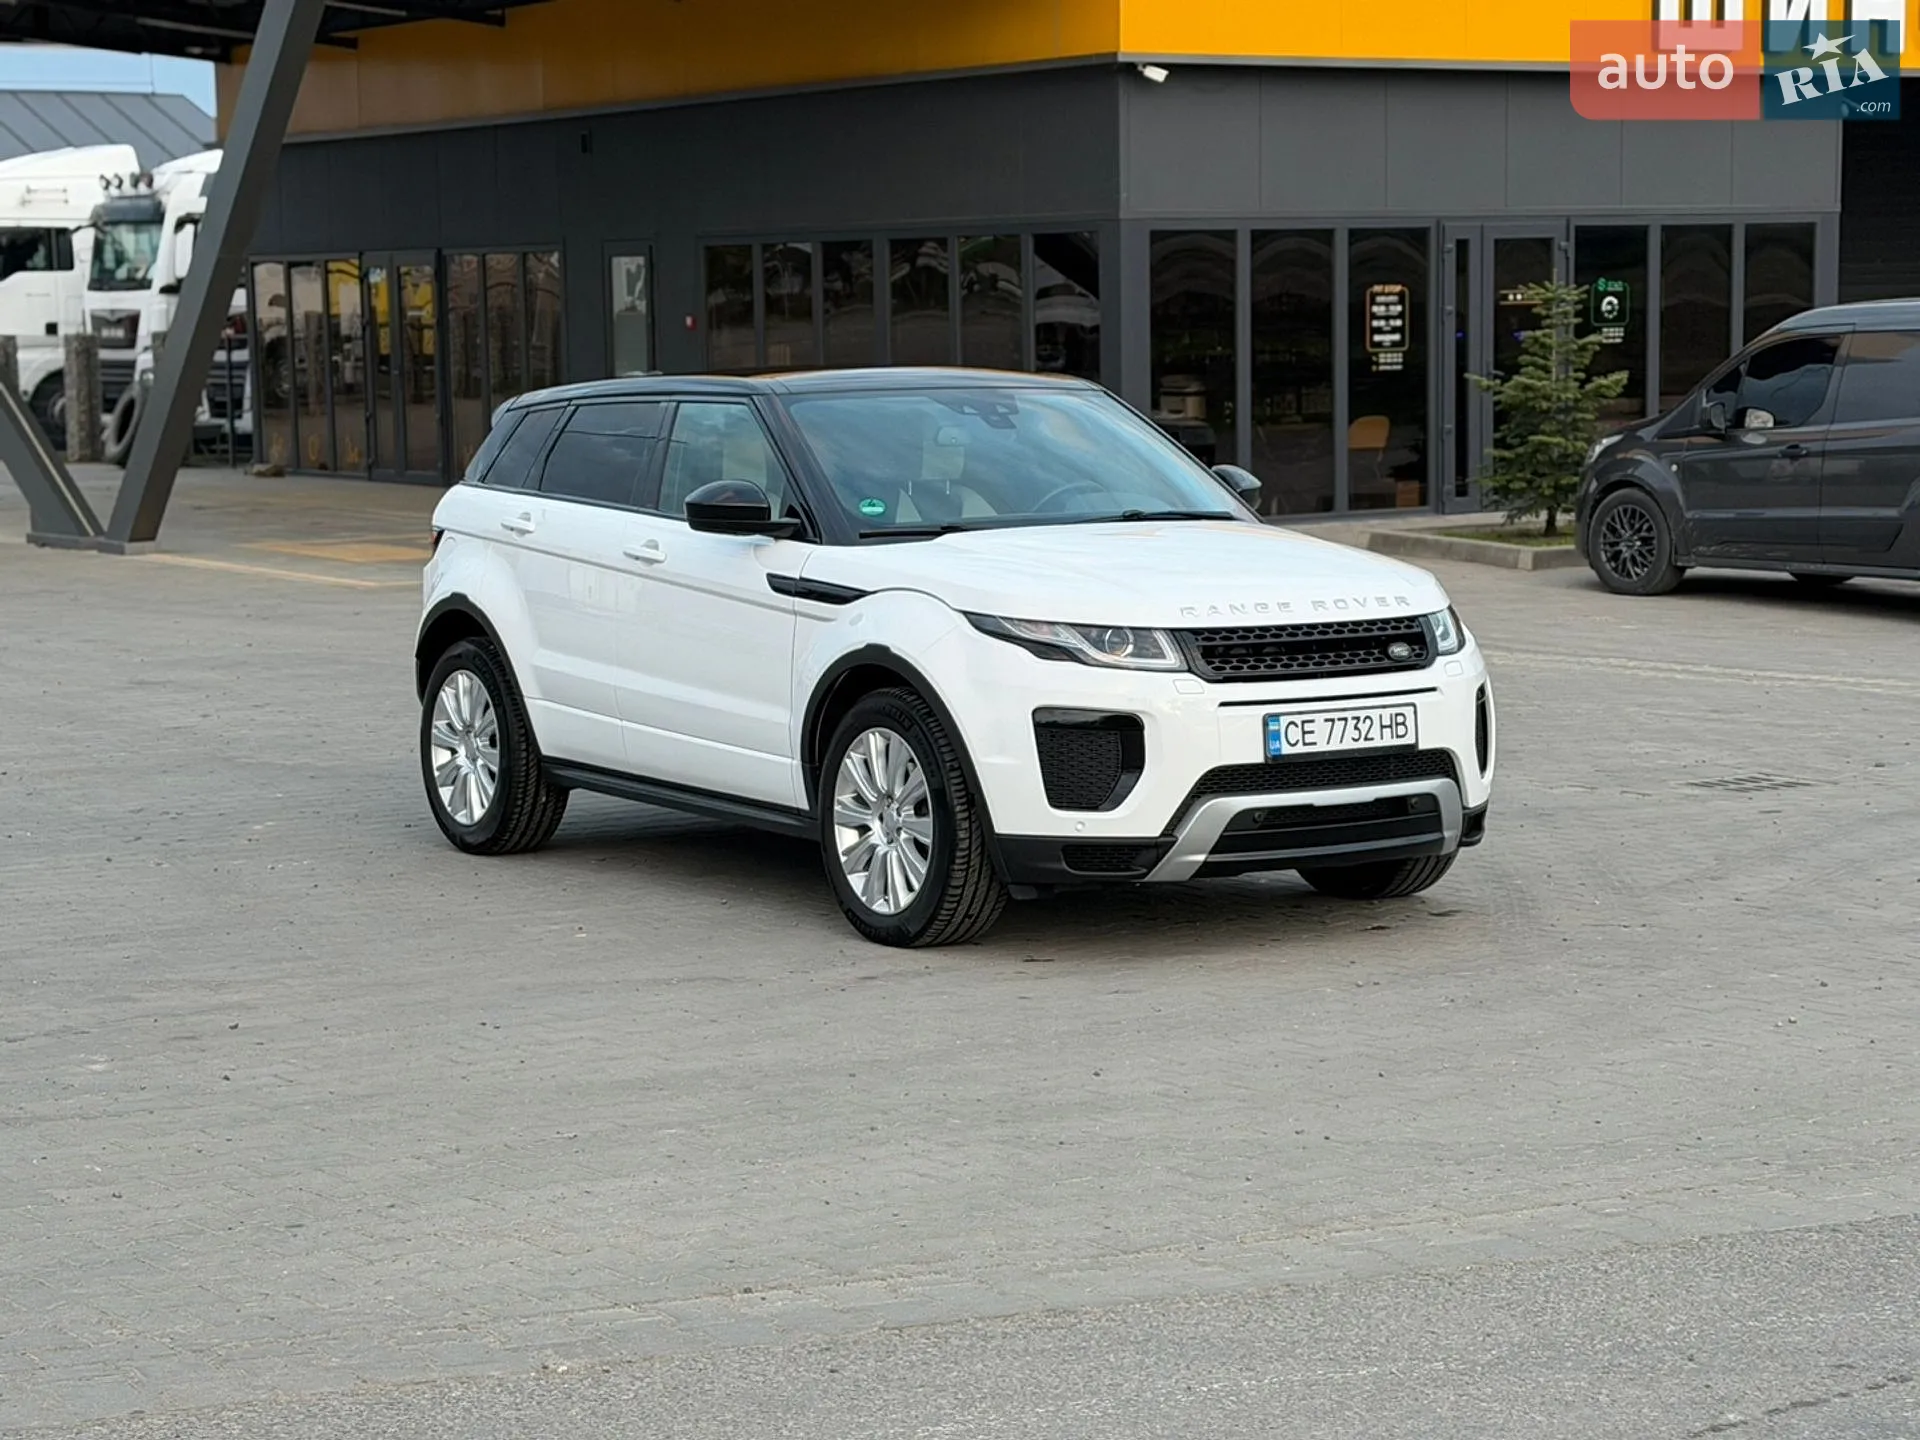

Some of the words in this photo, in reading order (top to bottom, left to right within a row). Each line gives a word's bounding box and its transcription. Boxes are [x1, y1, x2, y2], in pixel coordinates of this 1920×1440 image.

[1179, 601, 1294, 619] RANGE
[1310, 596, 1412, 612] ROVER
[1284, 717, 1318, 747] CE
[1323, 713, 1375, 746] 7732
[1378, 711, 1409, 741] HB
